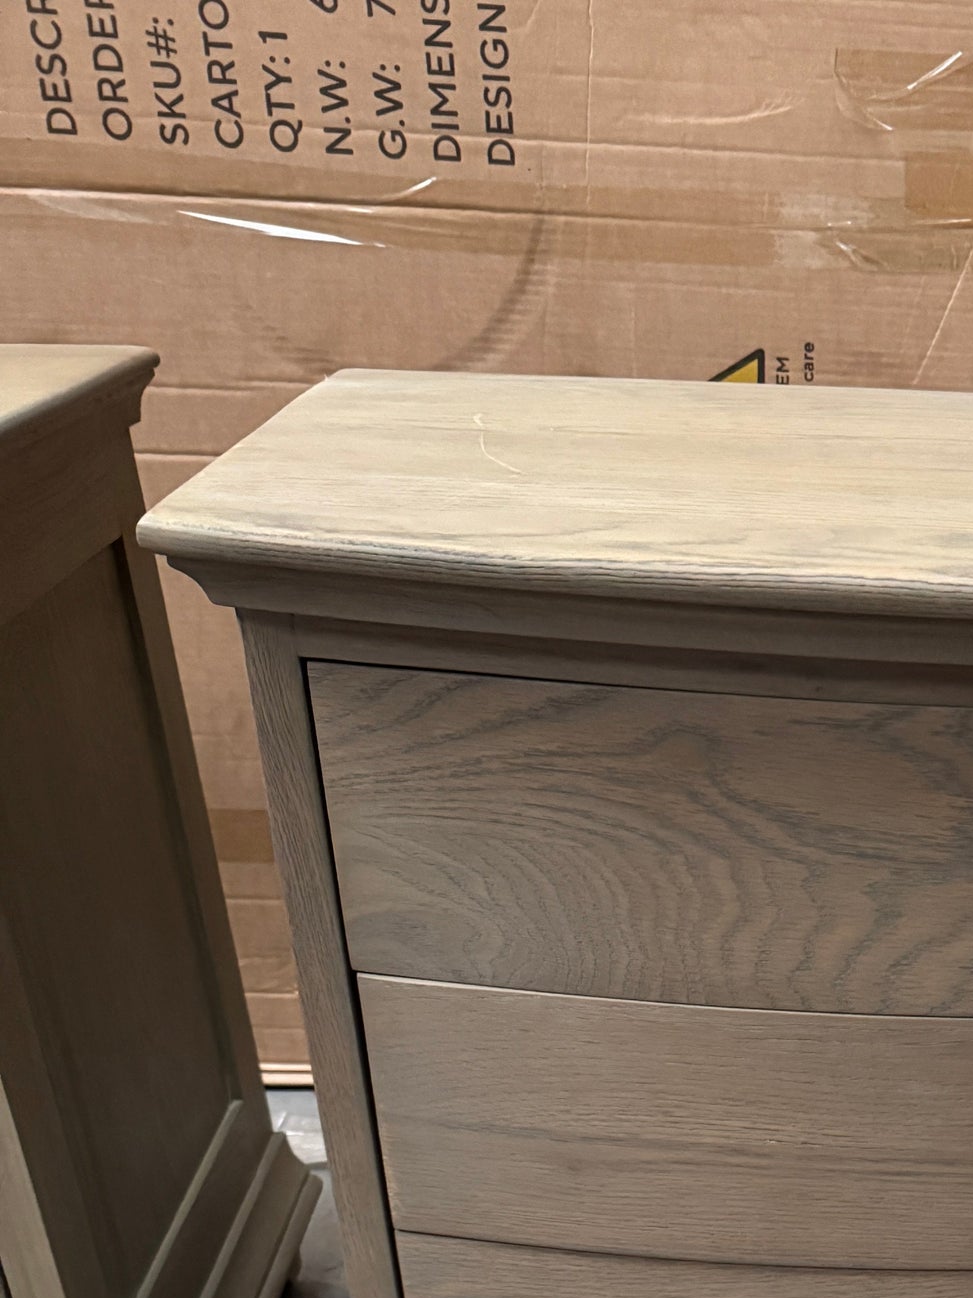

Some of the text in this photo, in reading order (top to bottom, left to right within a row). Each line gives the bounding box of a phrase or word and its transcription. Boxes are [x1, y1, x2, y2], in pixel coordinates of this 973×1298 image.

[145, 17, 190, 145] SKU#:
[198, 0, 244, 149] CARTO
[317, 60, 354, 156] N.W:
[372, 64, 408, 160] G.W:
[420, 0, 462, 162] DIMENS
[477, 3, 515, 166] DESIGN
[804, 342, 815, 382] care
